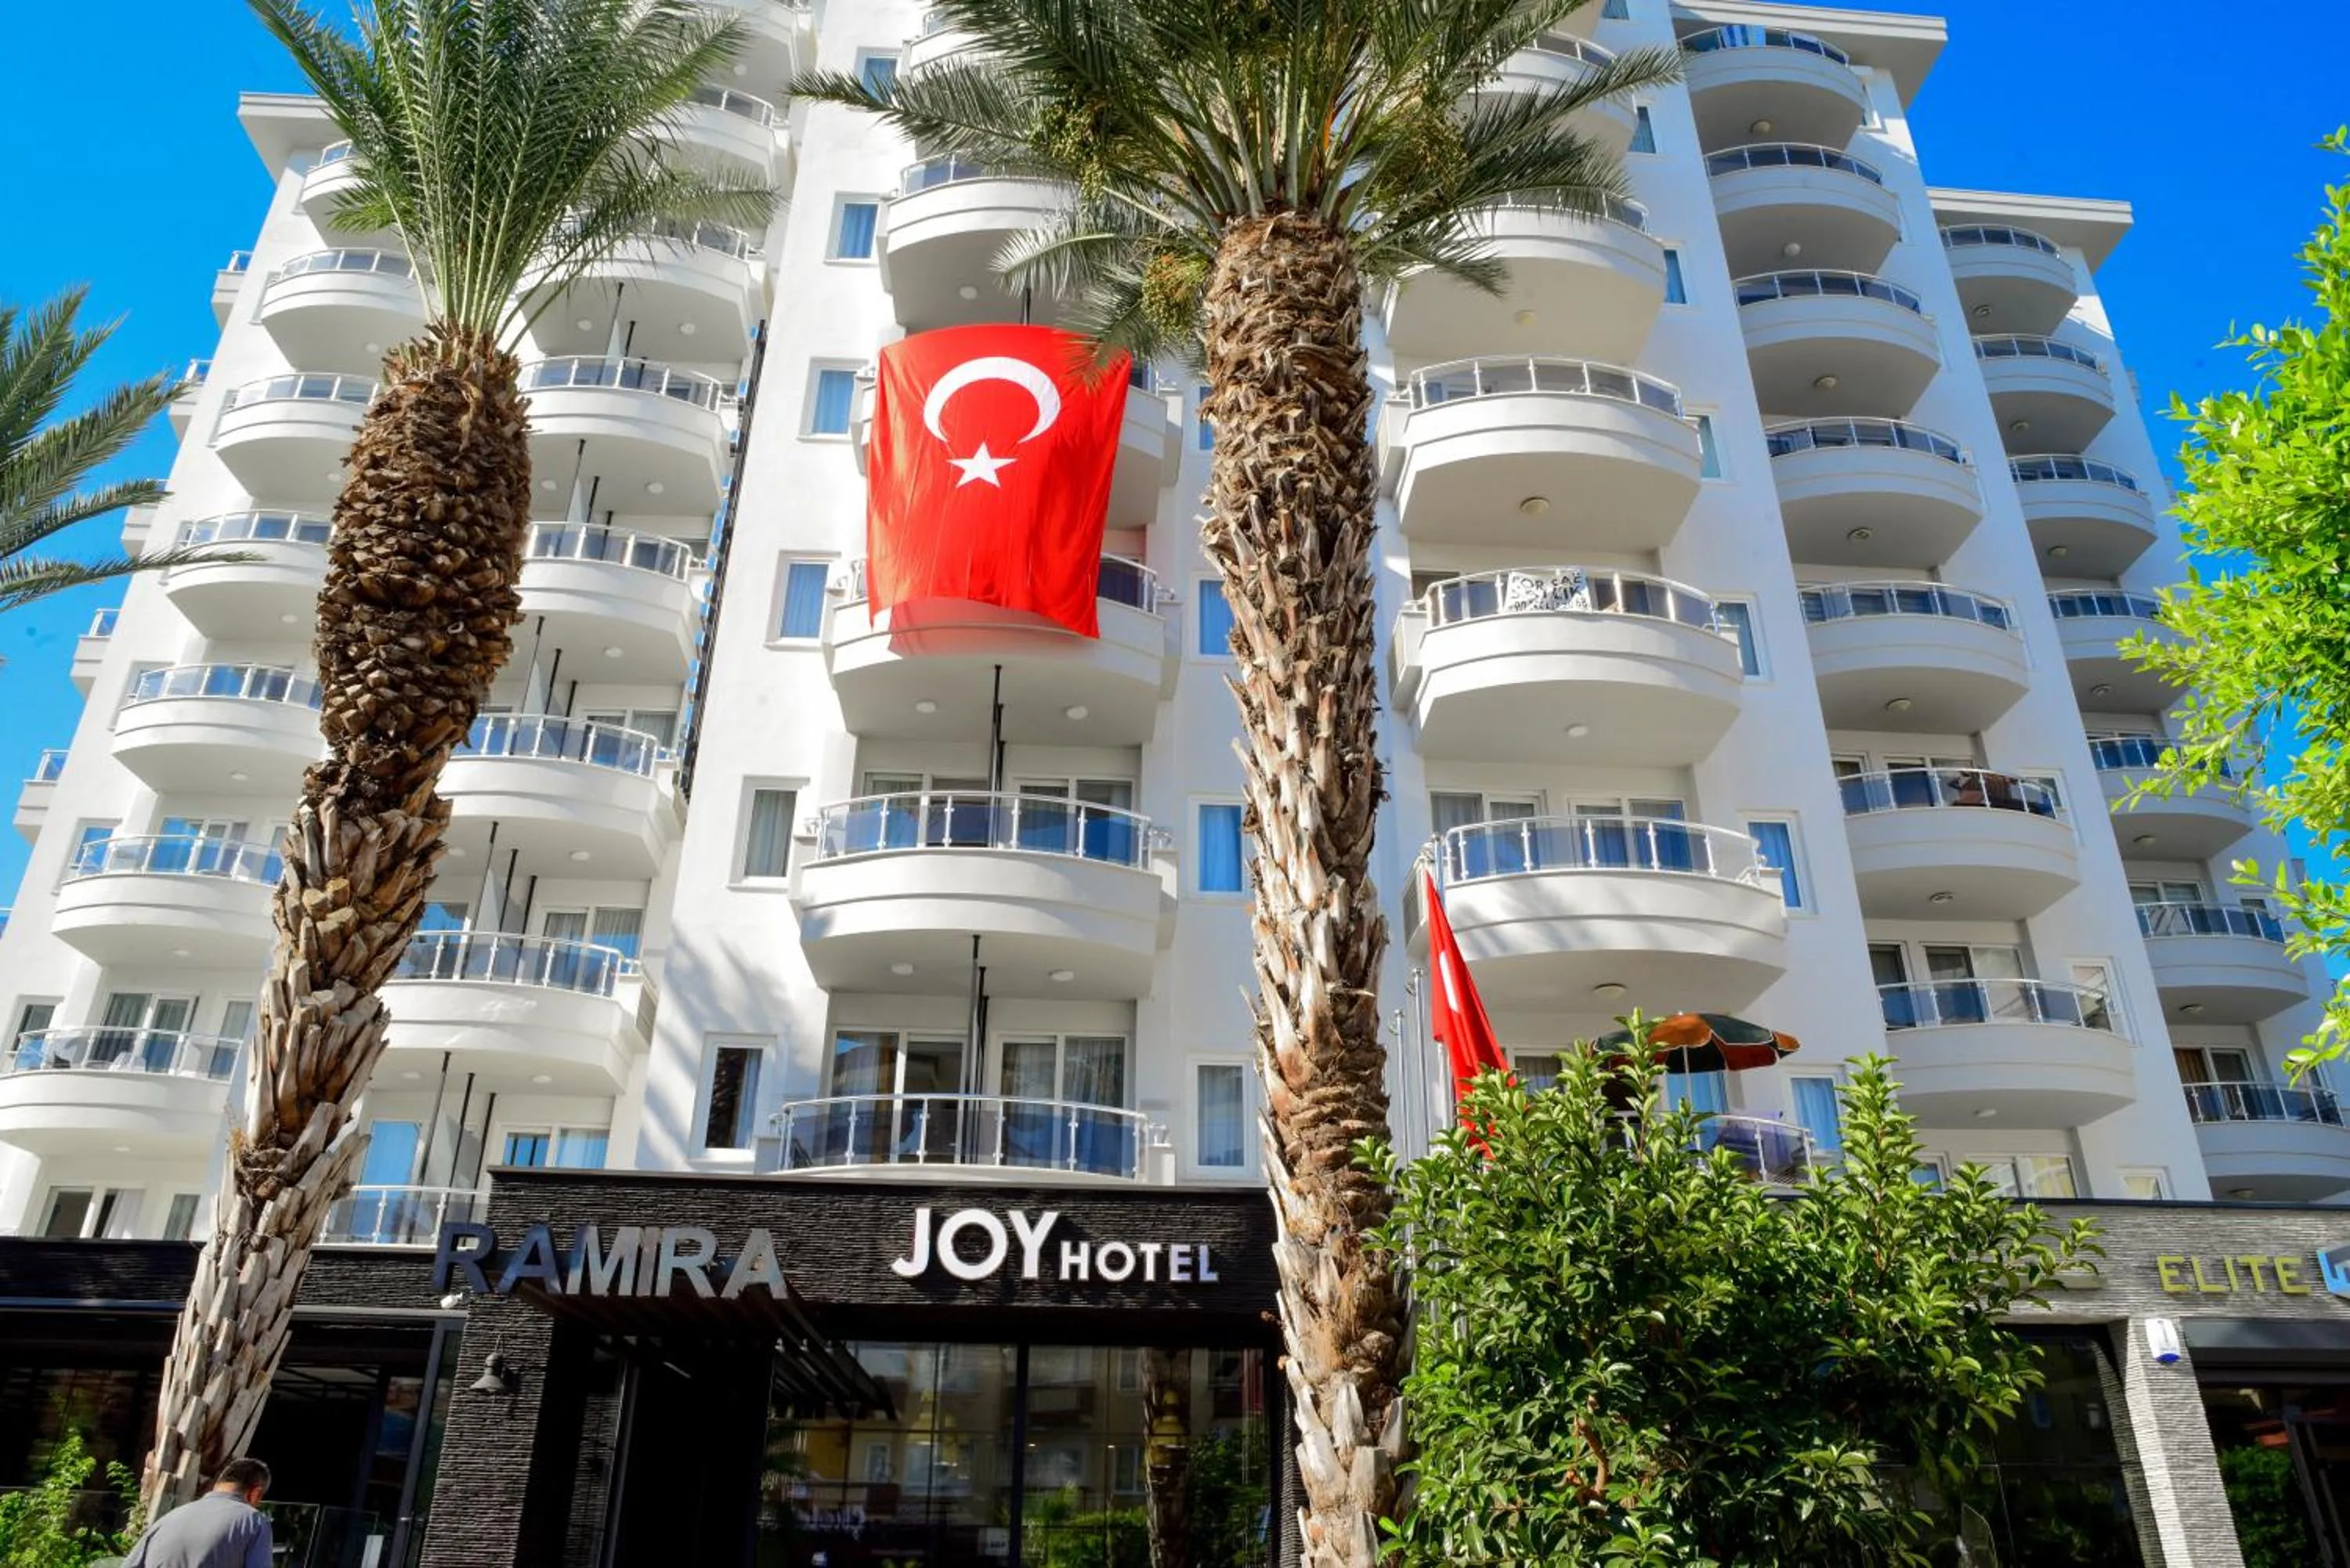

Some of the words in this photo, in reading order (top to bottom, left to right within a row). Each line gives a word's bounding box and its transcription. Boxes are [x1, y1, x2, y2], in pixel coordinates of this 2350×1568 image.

[431, 1221, 789, 1300] RAMIRA
[891, 1207, 1061, 1281] JOY
[1059, 1240, 1220, 1282] HOTEL
[2157, 1255, 2310, 1294] ELITE
